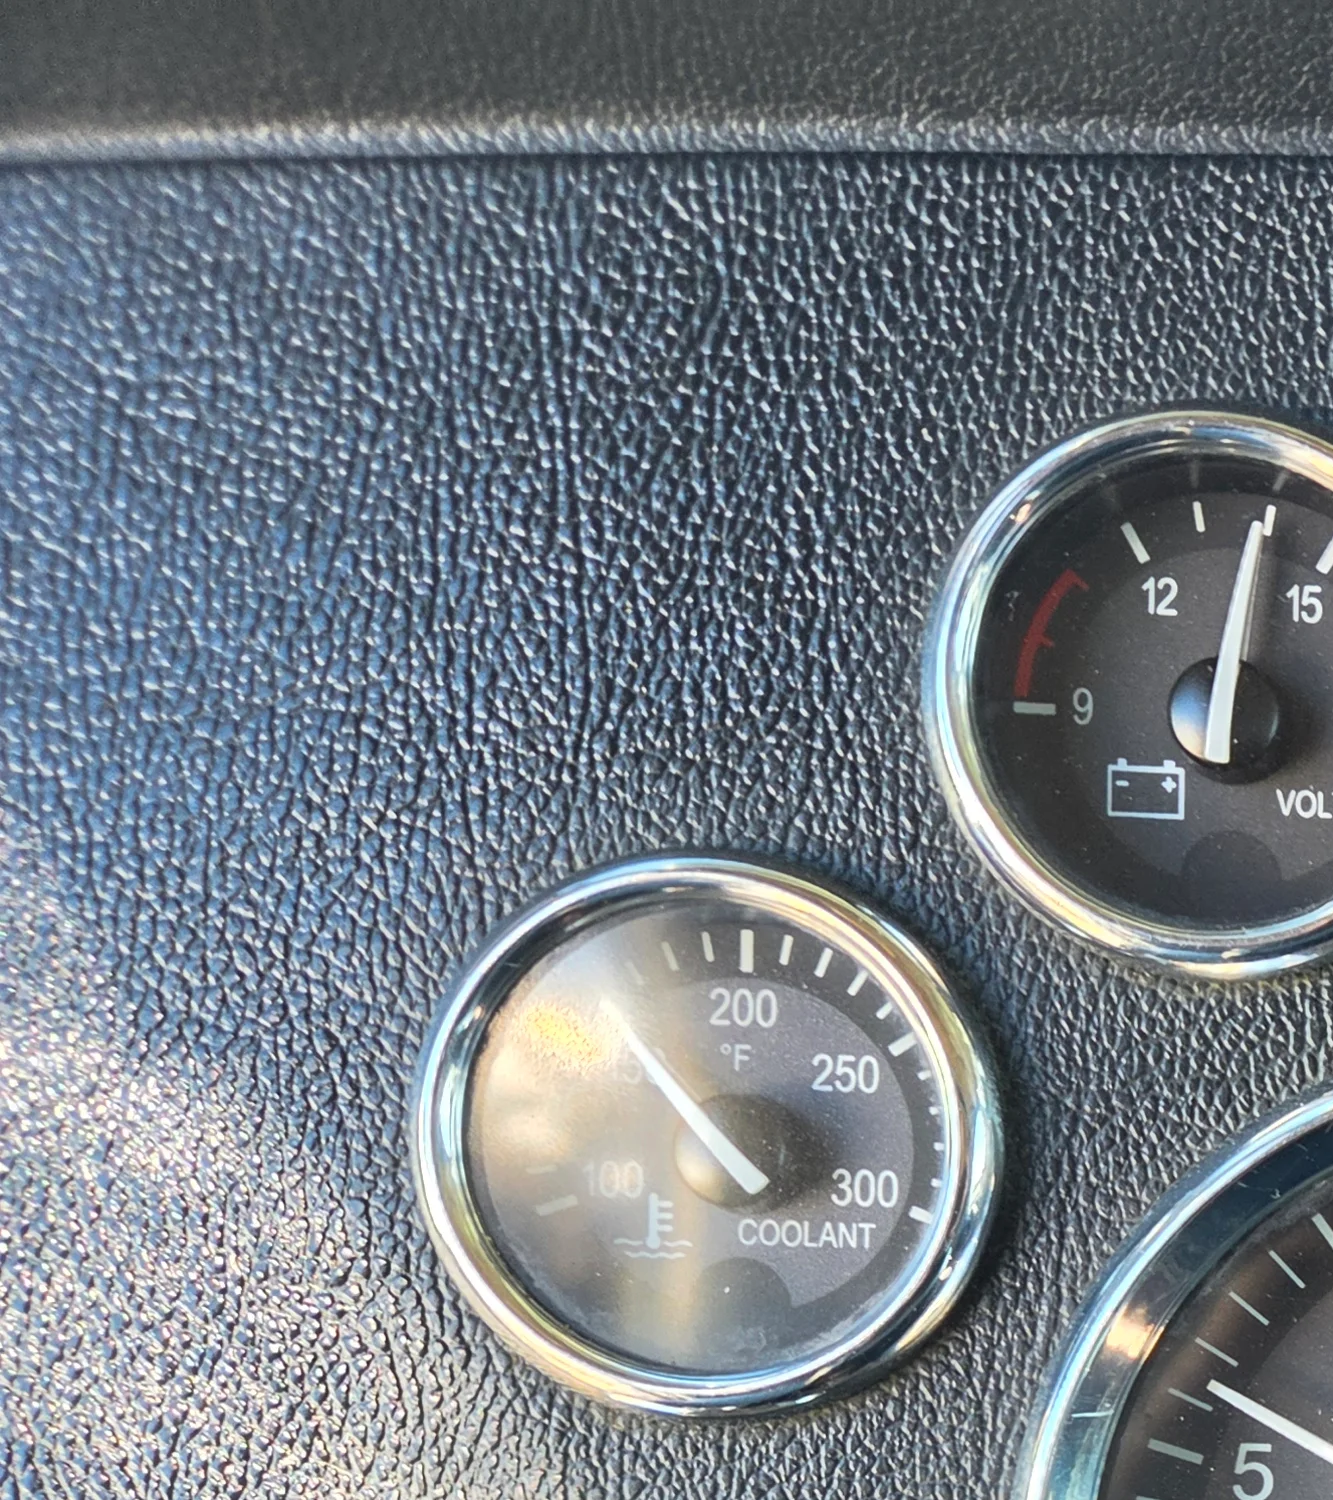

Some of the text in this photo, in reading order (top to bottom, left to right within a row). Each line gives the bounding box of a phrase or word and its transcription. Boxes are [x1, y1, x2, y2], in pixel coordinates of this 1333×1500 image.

[1141, 577, 1178, 617] 12
[1286, 585, 1323, 624] 15
[1073, 687, 1094, 725] 9
[709, 988, 777, 1028] 200
[811, 1054, 880, 1094] 250
[584, 1159, 643, 1199] 100
[830, 1169, 898, 1207] 300
[737, 1219, 877, 1249] COOLANT
